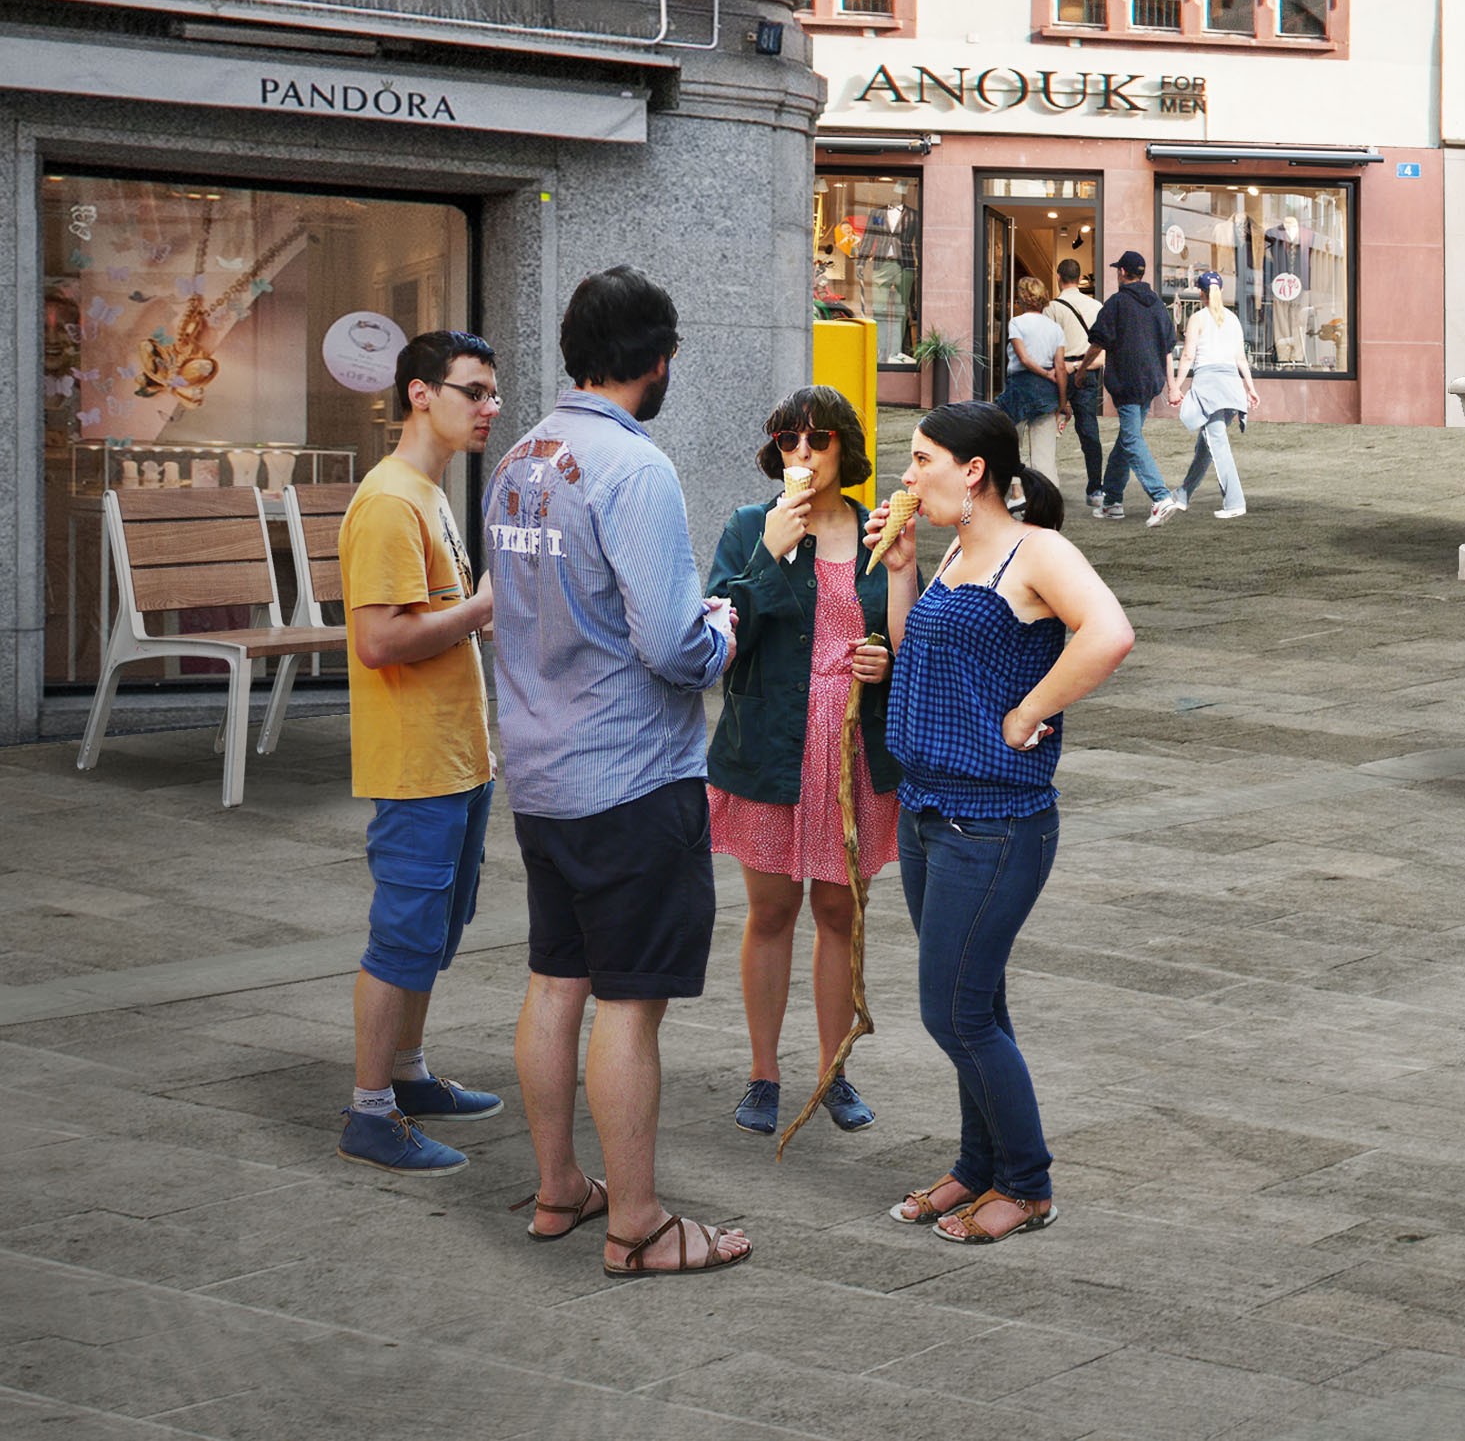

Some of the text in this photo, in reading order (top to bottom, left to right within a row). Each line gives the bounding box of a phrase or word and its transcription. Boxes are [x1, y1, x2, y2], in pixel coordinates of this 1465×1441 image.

[854, 64, 1149, 112] ANOUK
[1160, 75, 1206, 93] FOR
[260, 77, 456, 121] PANDORA
[1160, 97, 1206, 115] MEN
[1403, 165, 1412, 176] 4
